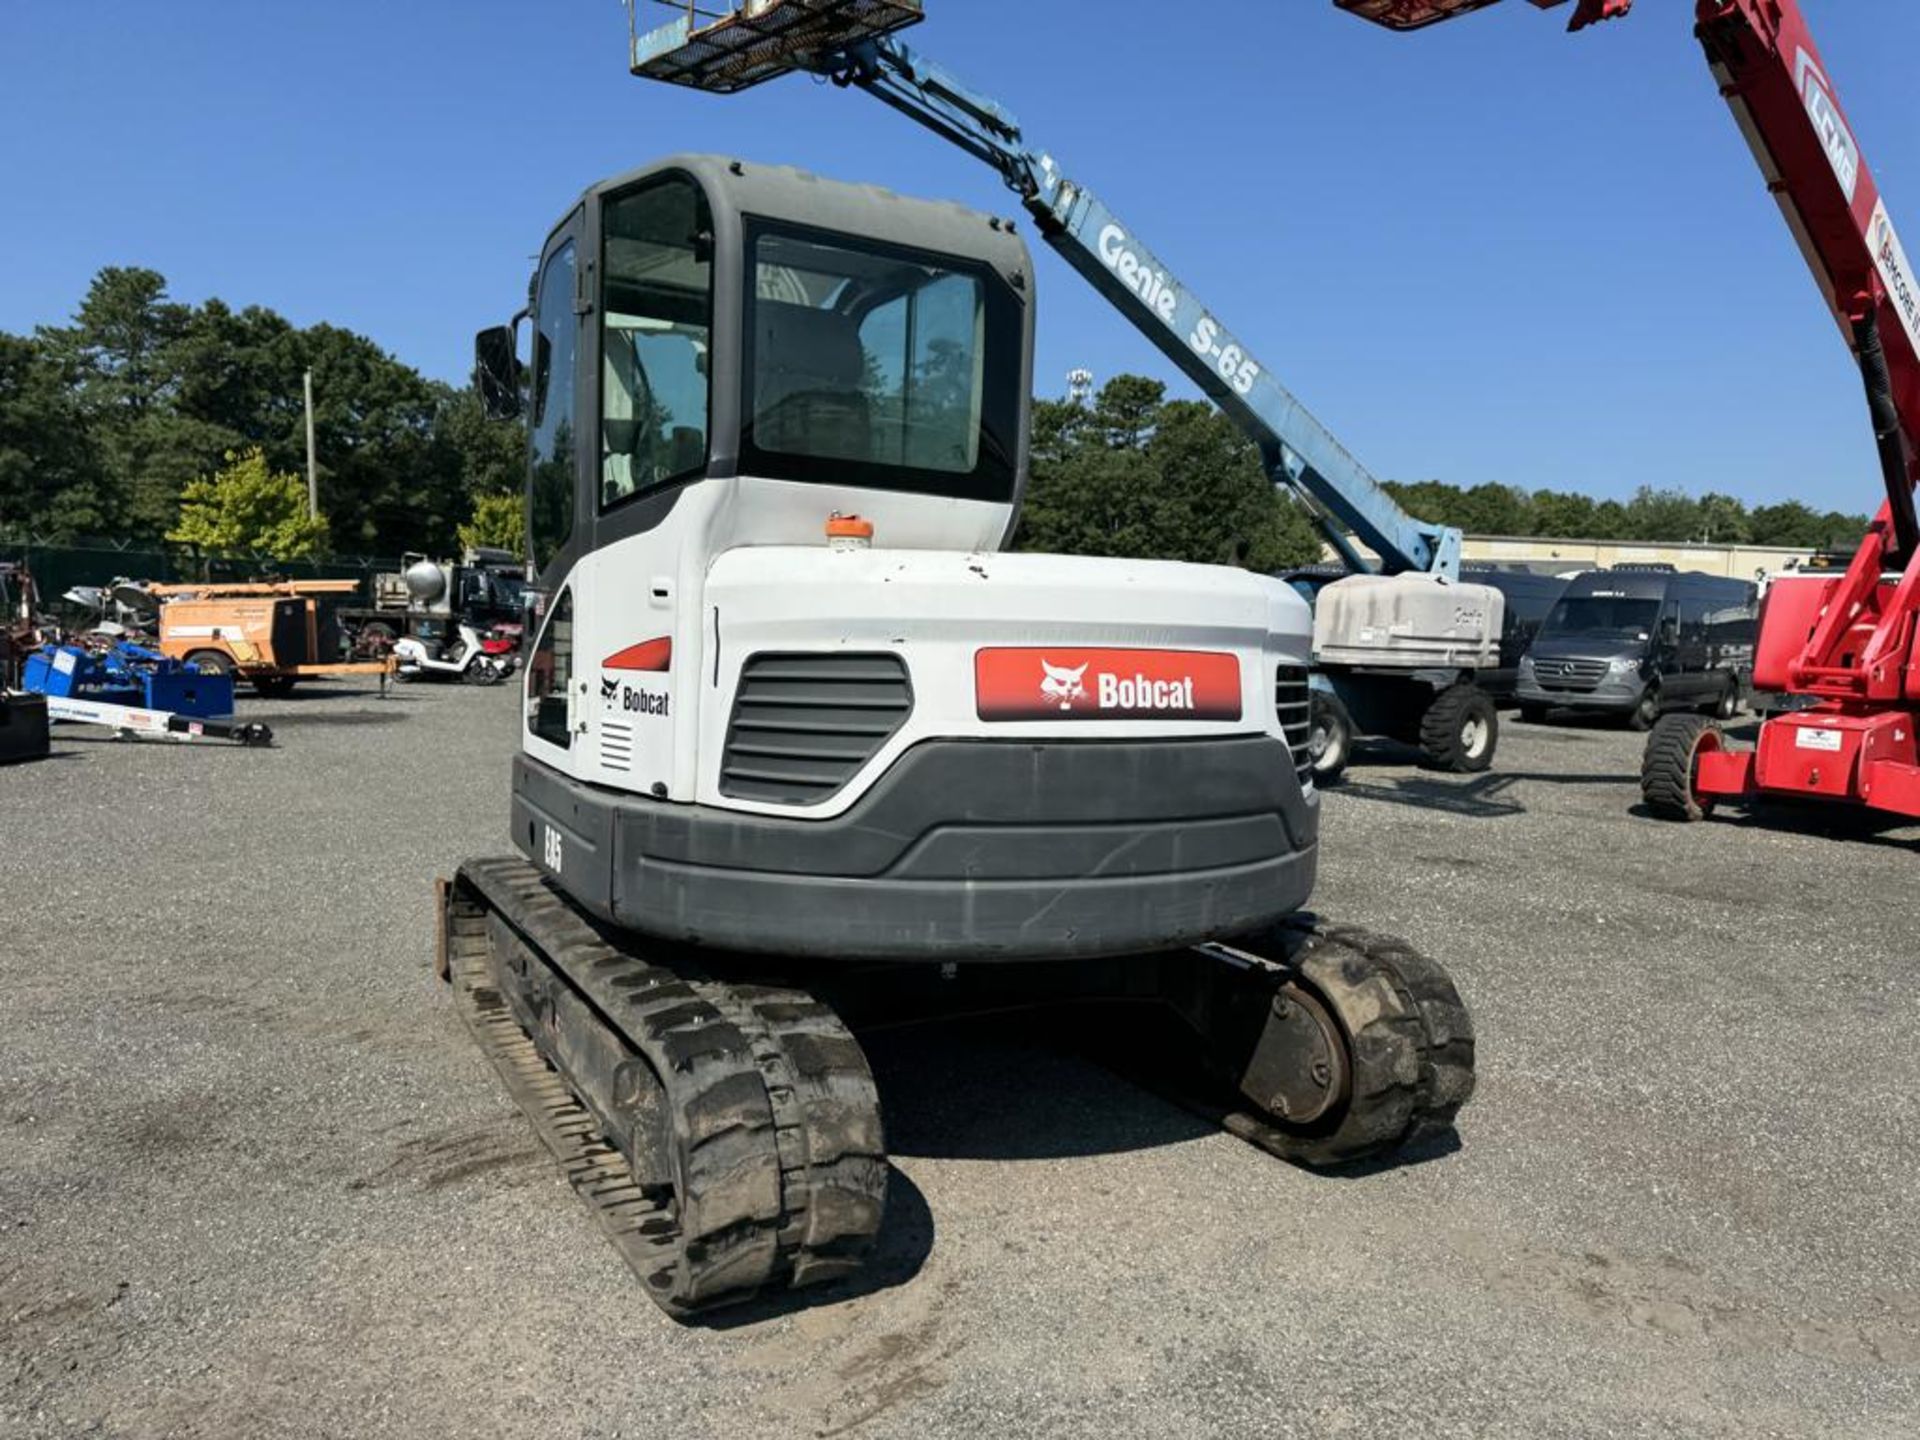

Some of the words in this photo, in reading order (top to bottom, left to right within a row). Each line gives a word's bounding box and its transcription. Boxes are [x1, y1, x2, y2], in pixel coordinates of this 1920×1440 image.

[1098, 224, 1177, 322] Genie
[1190, 317, 1260, 393] S-65
[623, 686, 669, 716] Bobcat
[1098, 672, 1195, 709] Bobcat
